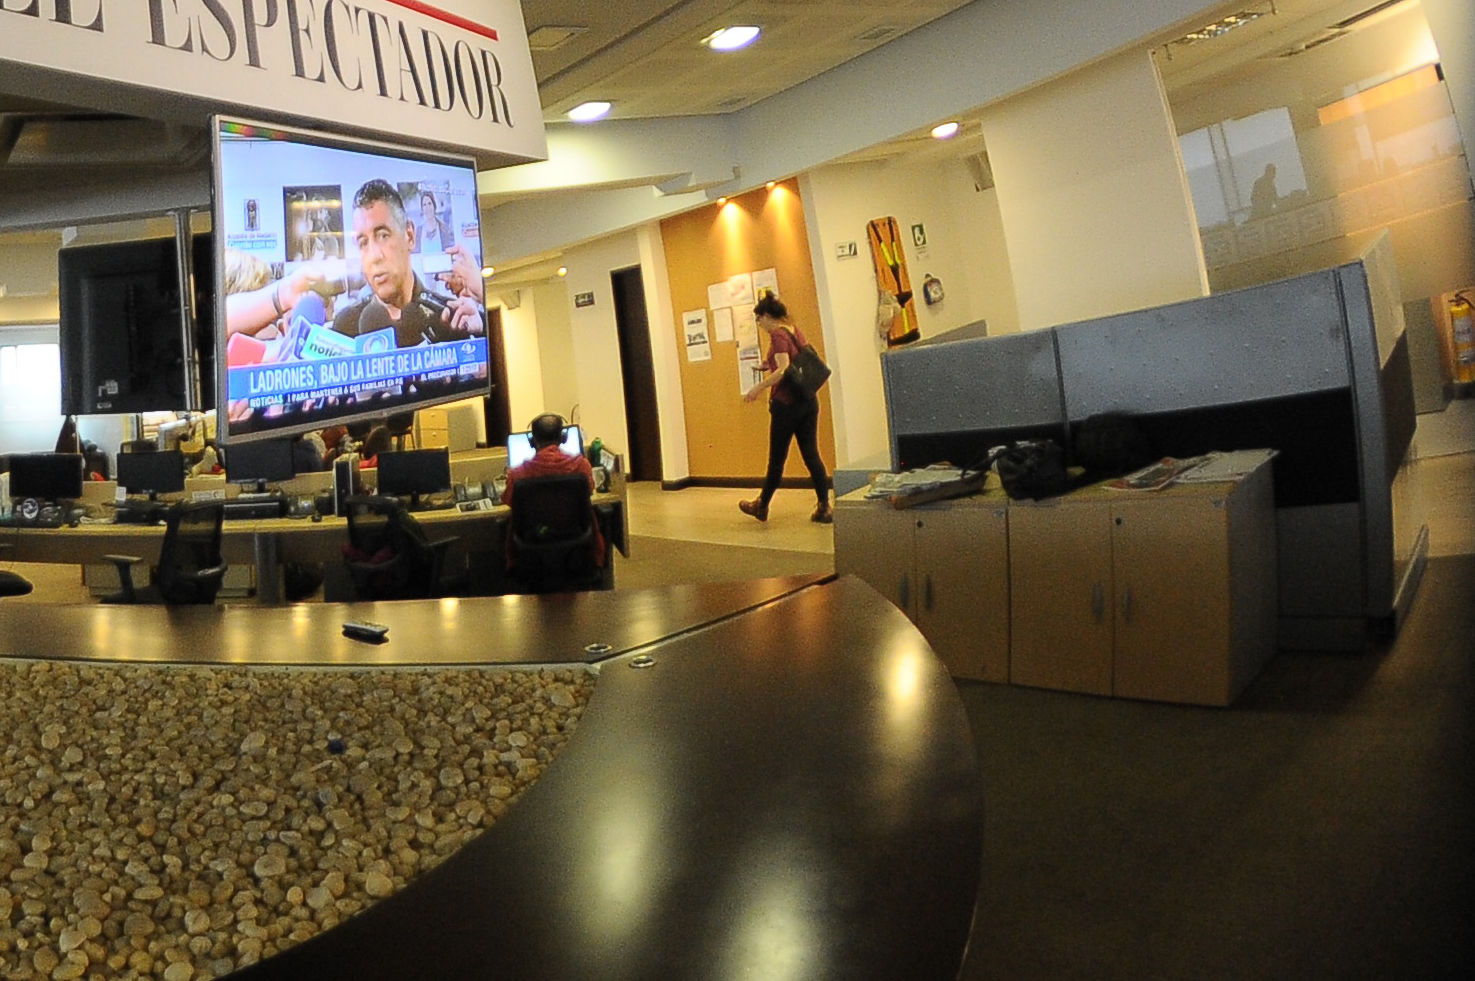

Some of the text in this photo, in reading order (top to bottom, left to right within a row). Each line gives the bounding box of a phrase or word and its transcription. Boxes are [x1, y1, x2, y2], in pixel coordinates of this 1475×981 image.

[250, 365, 317, 393] LADRONES,
[320, 360, 347, 385] BAJO
[351, 360, 364, 380] LA
[367, 355, 395, 377] LENTE
[397, 353, 409, 373] DE
[411, 351, 422, 371] LA
[424, 346, 458, 369] CÁMARA
[249, 394, 283, 408] NOTICIAS
[291, 391, 309, 402] PARA
